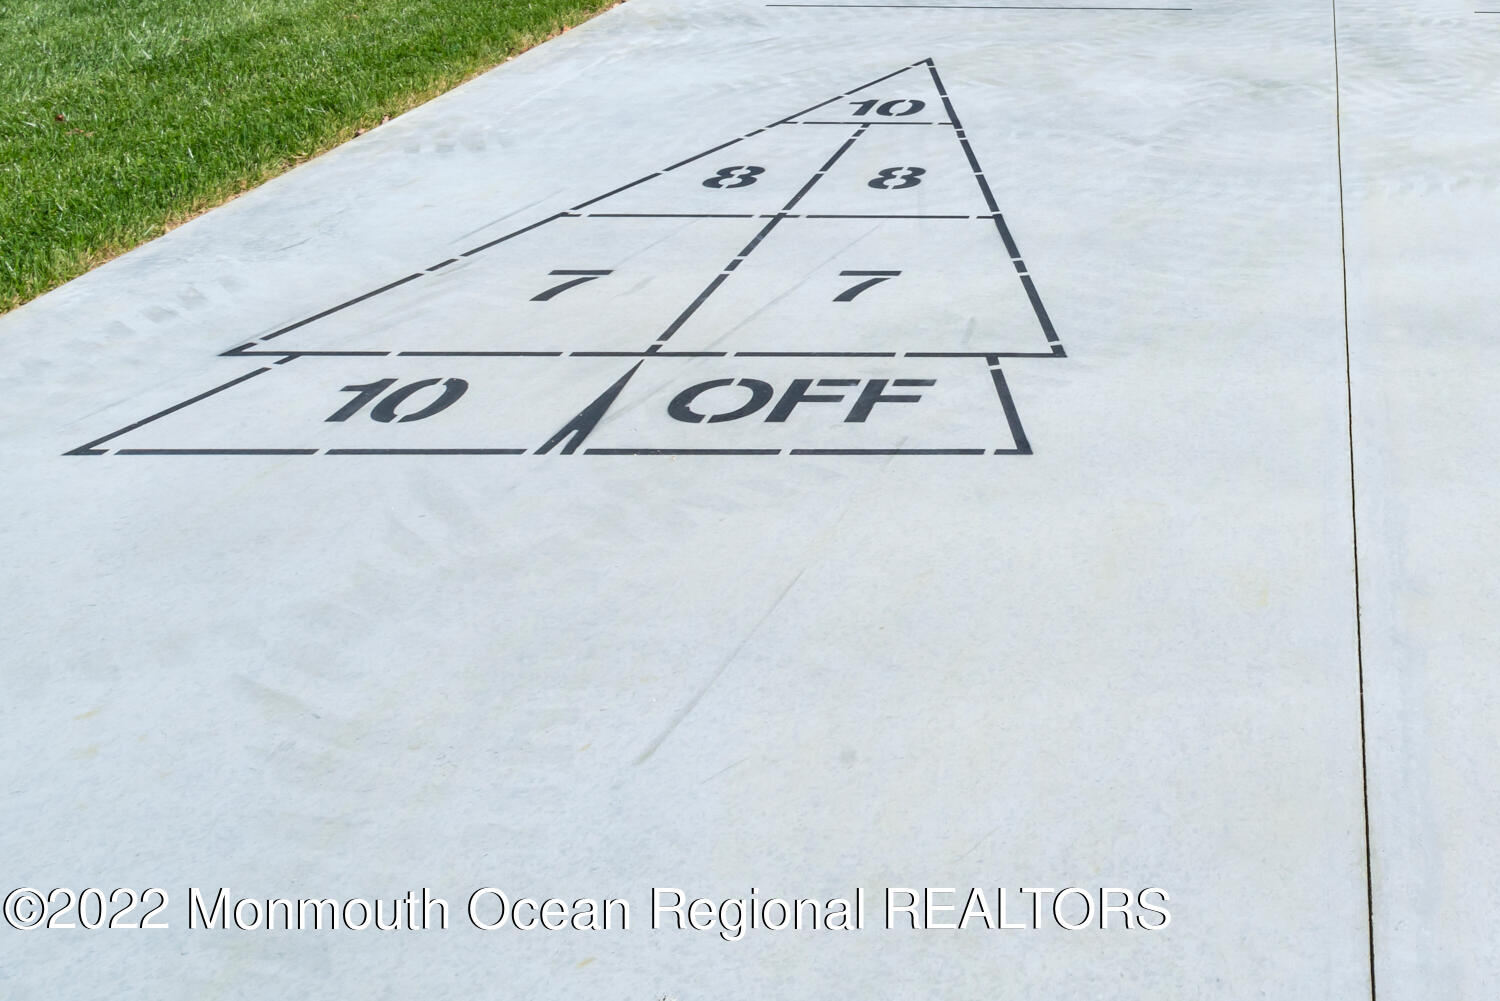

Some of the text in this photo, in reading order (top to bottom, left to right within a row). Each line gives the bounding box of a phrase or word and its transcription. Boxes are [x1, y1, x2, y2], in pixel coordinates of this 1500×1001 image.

[850, 100, 926, 117] 10
[702, 165, 926, 190] 8 8
[530, 269, 902, 302] 7 7
[325, 377, 938, 424] 10 OFF
